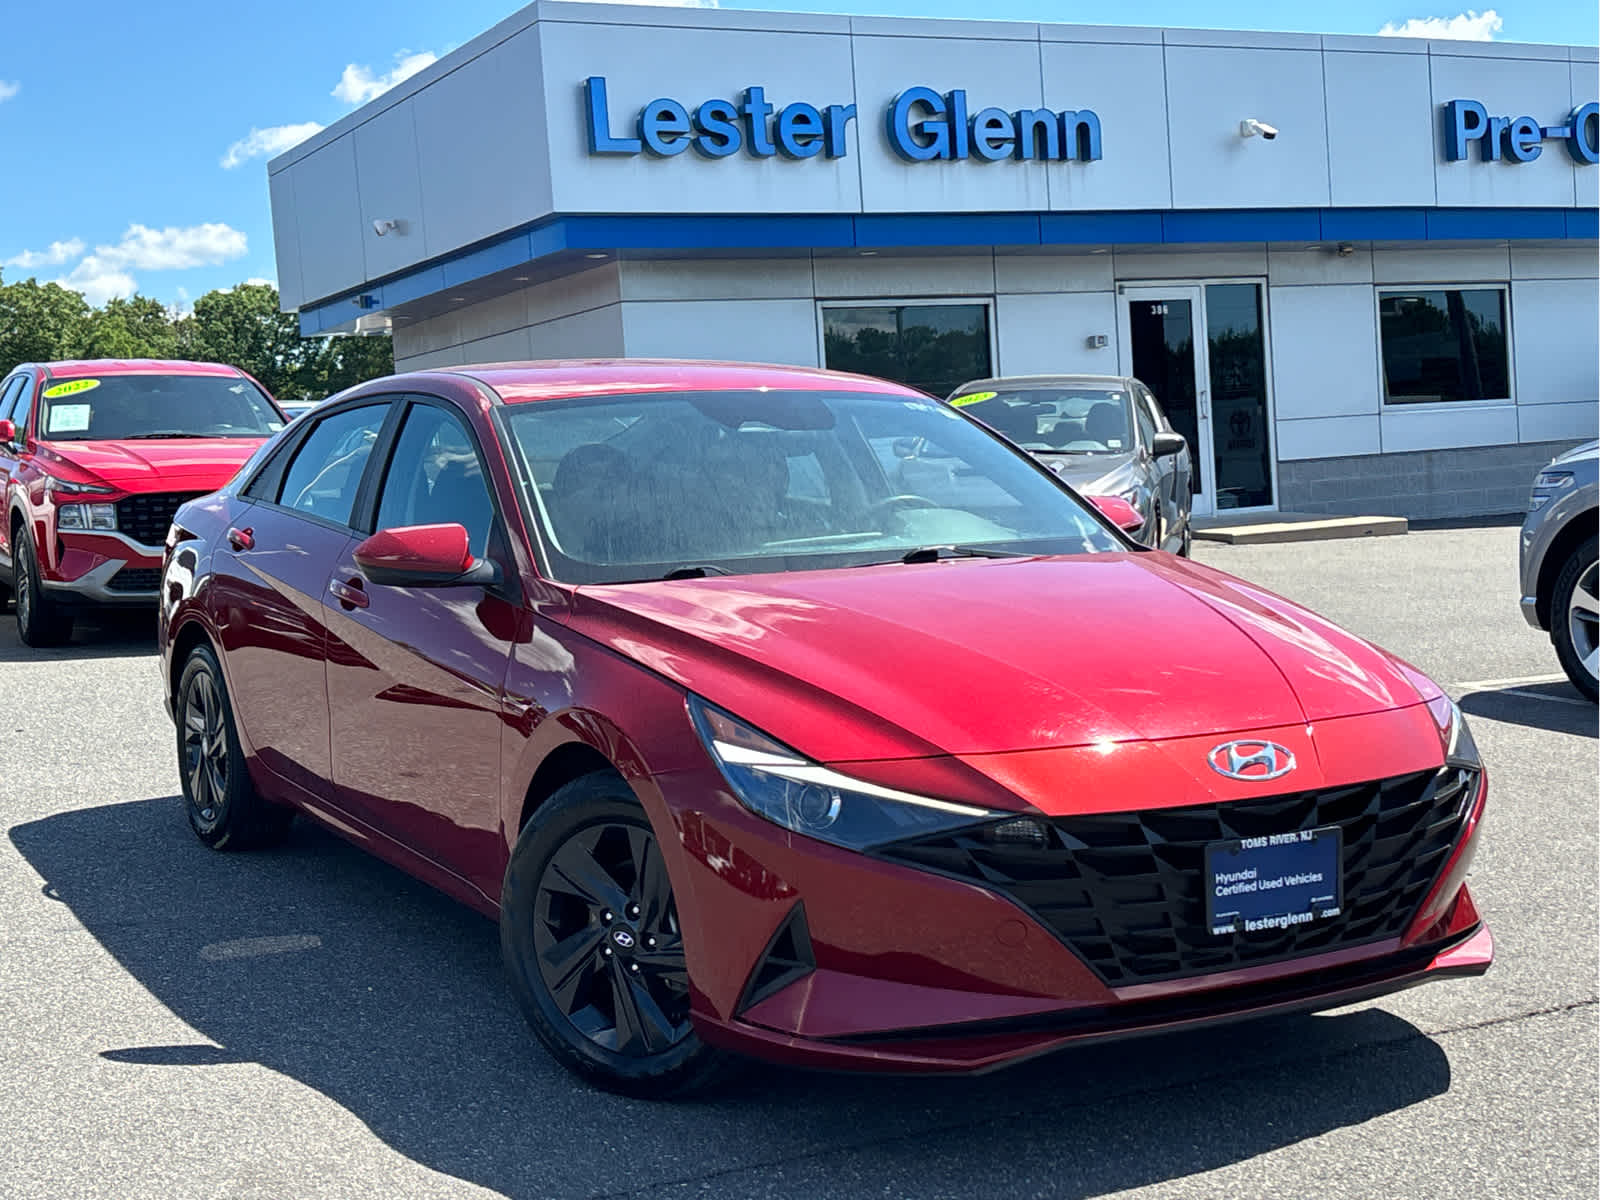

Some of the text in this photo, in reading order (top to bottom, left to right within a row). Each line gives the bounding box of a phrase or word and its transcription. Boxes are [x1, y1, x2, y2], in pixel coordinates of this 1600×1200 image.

[586, 77, 1103, 163] Lester Glenn
[55, 380, 89, 396] 2022
[1240, 836, 1267, 849] TOMS
[1300, 830, 1313, 841] NJ
[1215, 867, 1257, 885] Hyundai
[1215, 872, 1323, 896] Certified Used Vehicles
[1244, 911, 1313, 932] lesterglenn
